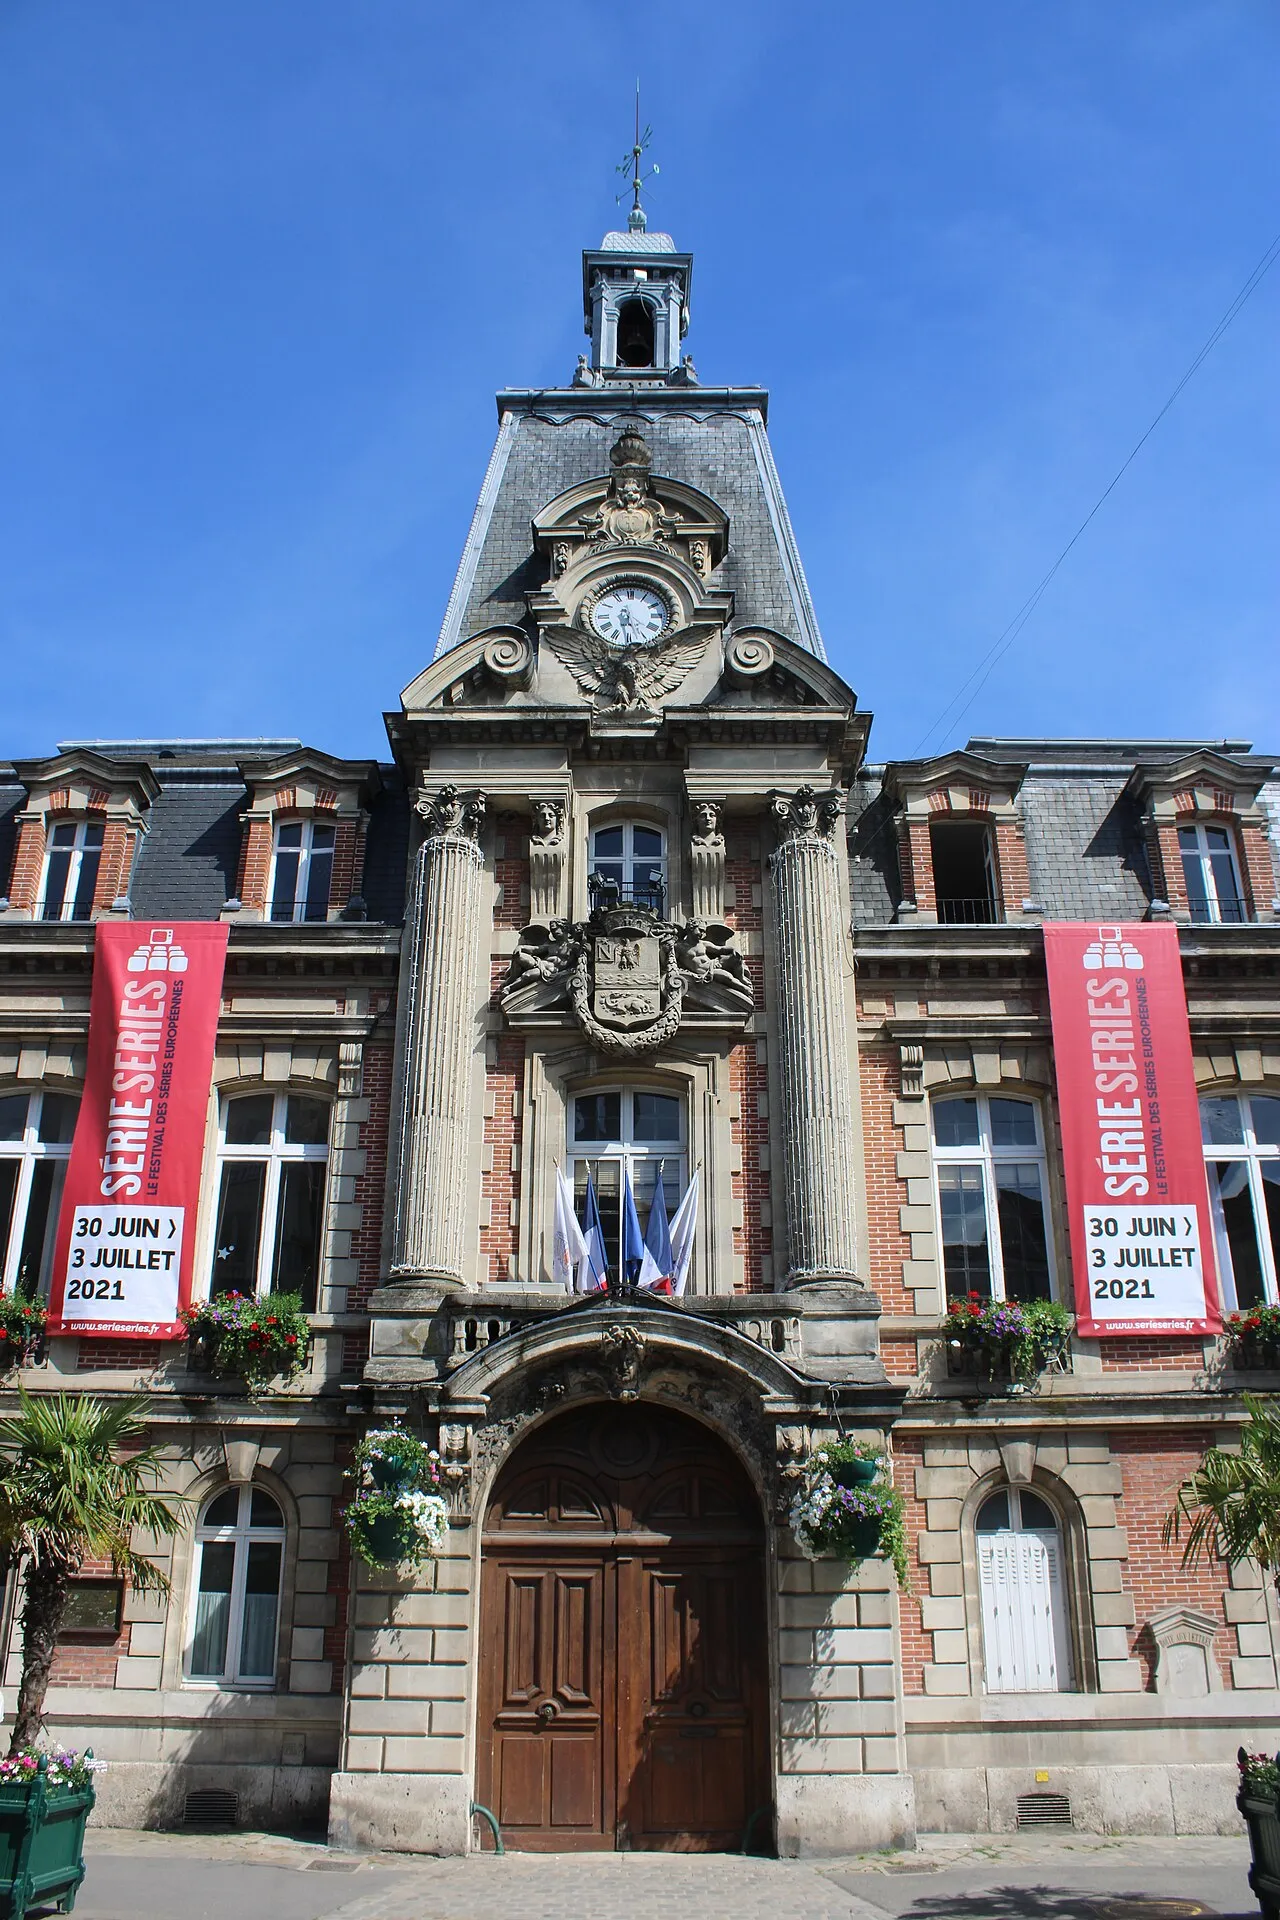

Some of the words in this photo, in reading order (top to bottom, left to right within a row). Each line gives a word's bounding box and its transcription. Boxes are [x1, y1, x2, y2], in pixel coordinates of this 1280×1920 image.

[164, 980, 184, 1059] EUROPÉENNES
[1136, 977, 1153, 1057] EUROPÉENNES
[112, 980, 167, 1093] SERIES
[1086, 978, 1138, 1093] SERIES
[158, 1062, 173, 1098] SÉRIES
[1144, 1061, 1157, 1098] SÉRIES
[156, 1102, 168, 1124] DES
[1148, 1101, 1161, 1123] DES
[99, 1098, 153, 1196] SÉRIE
[149, 1127, 165, 1179] FESTIVAL
[1095, 1098, 1149, 1196] SÉRIE
[1152, 1127, 1166, 1178] FESTIVAL
[147, 1182, 158, 1195] LE
[1157, 1182, 1168, 1195] LE
[76, 1217, 102, 1237] 30
[108, 1217, 160, 1238] JUIN
[1090, 1217, 1118, 1237] 30
[1126, 1217, 1176, 1236] JUIN
[72, 1248, 85, 1268] 3
[90, 1248, 175, 1270] JUILLET
[1091, 1248, 1106, 1267] 3
[1114, 1248, 1195, 1267] JUILLET
[68, 1280, 125, 1300] 2021
[1094, 1279, 1155, 1299] 2021
[71, 1323, 160, 1334] www.serieseries.fr
[1106, 1320, 1194, 1330] www.serieseries.fr
